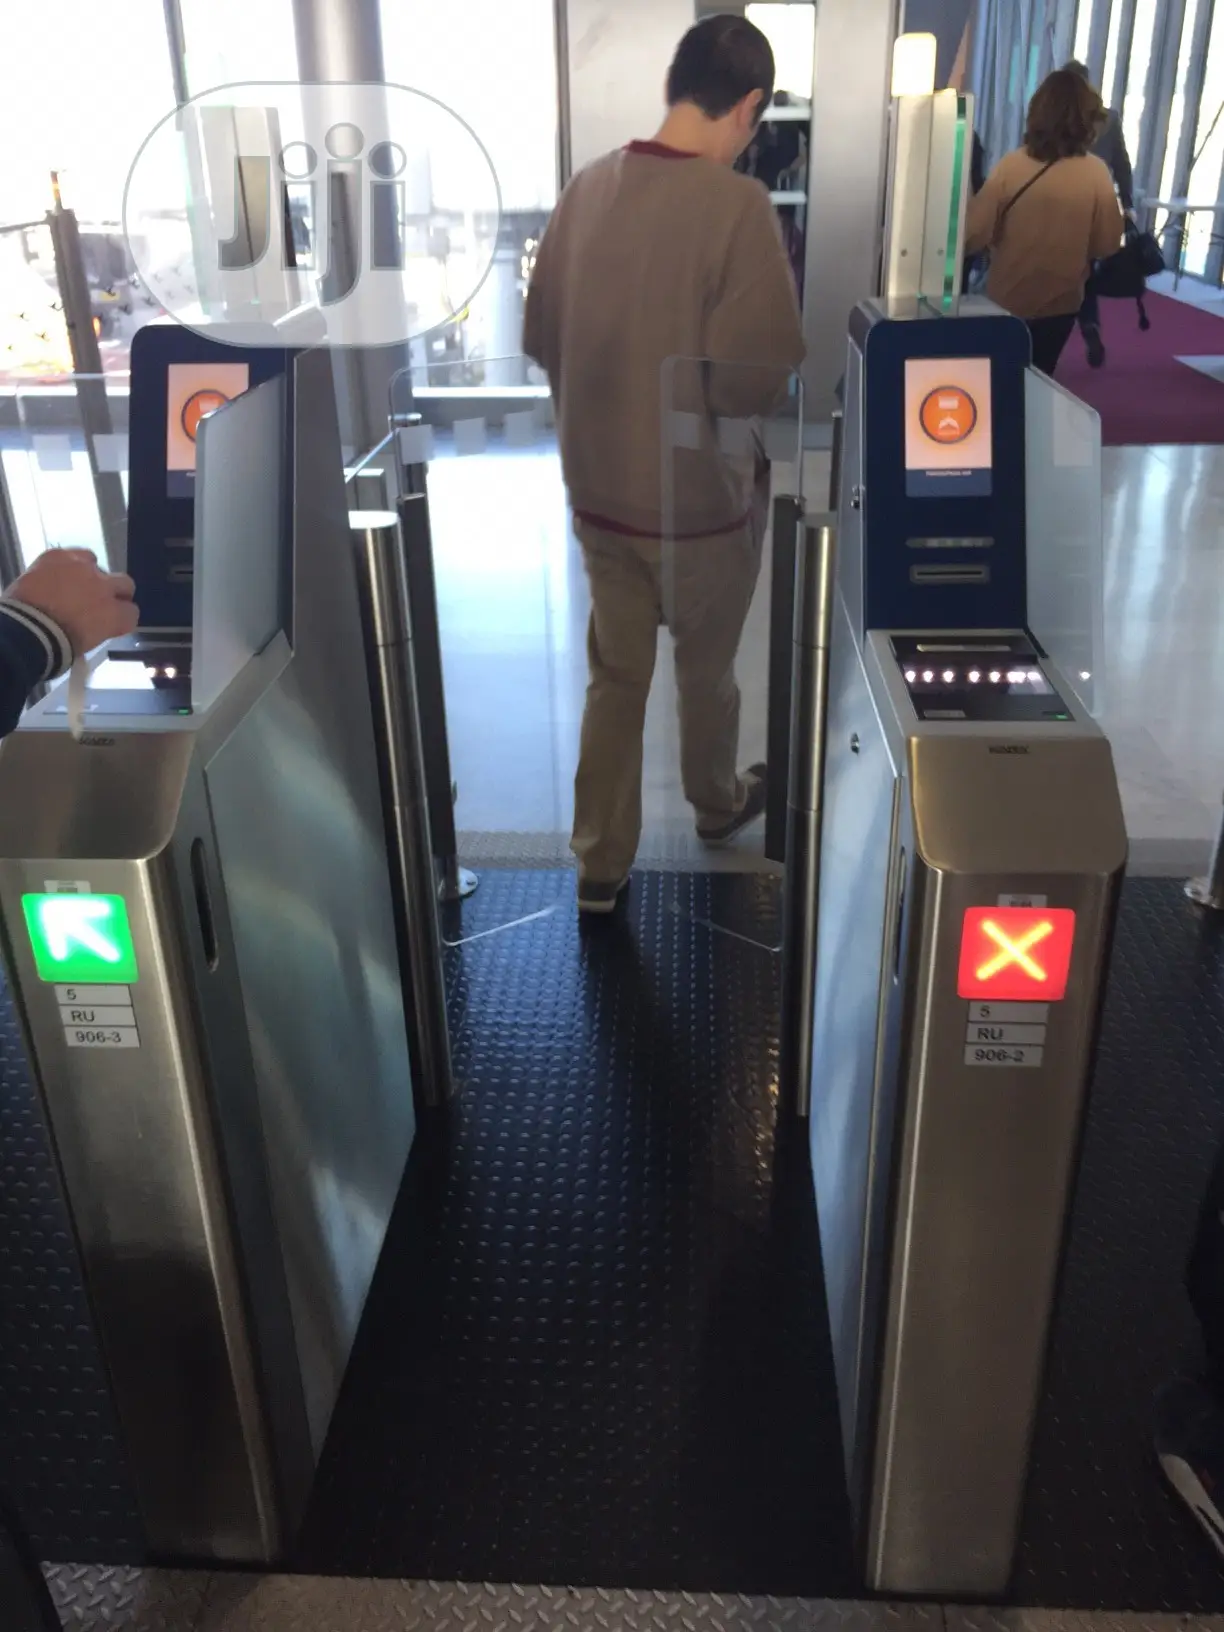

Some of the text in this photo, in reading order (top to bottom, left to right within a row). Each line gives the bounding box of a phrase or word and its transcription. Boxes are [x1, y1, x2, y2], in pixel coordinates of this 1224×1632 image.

[66, 988, 77, 1001] 5
[71, 1010, 95, 1022] RU
[75, 1031, 121, 1043] 906-3
[977, 1027, 1003, 1040] RU
[974, 1049, 1024, 1062] 906-2
